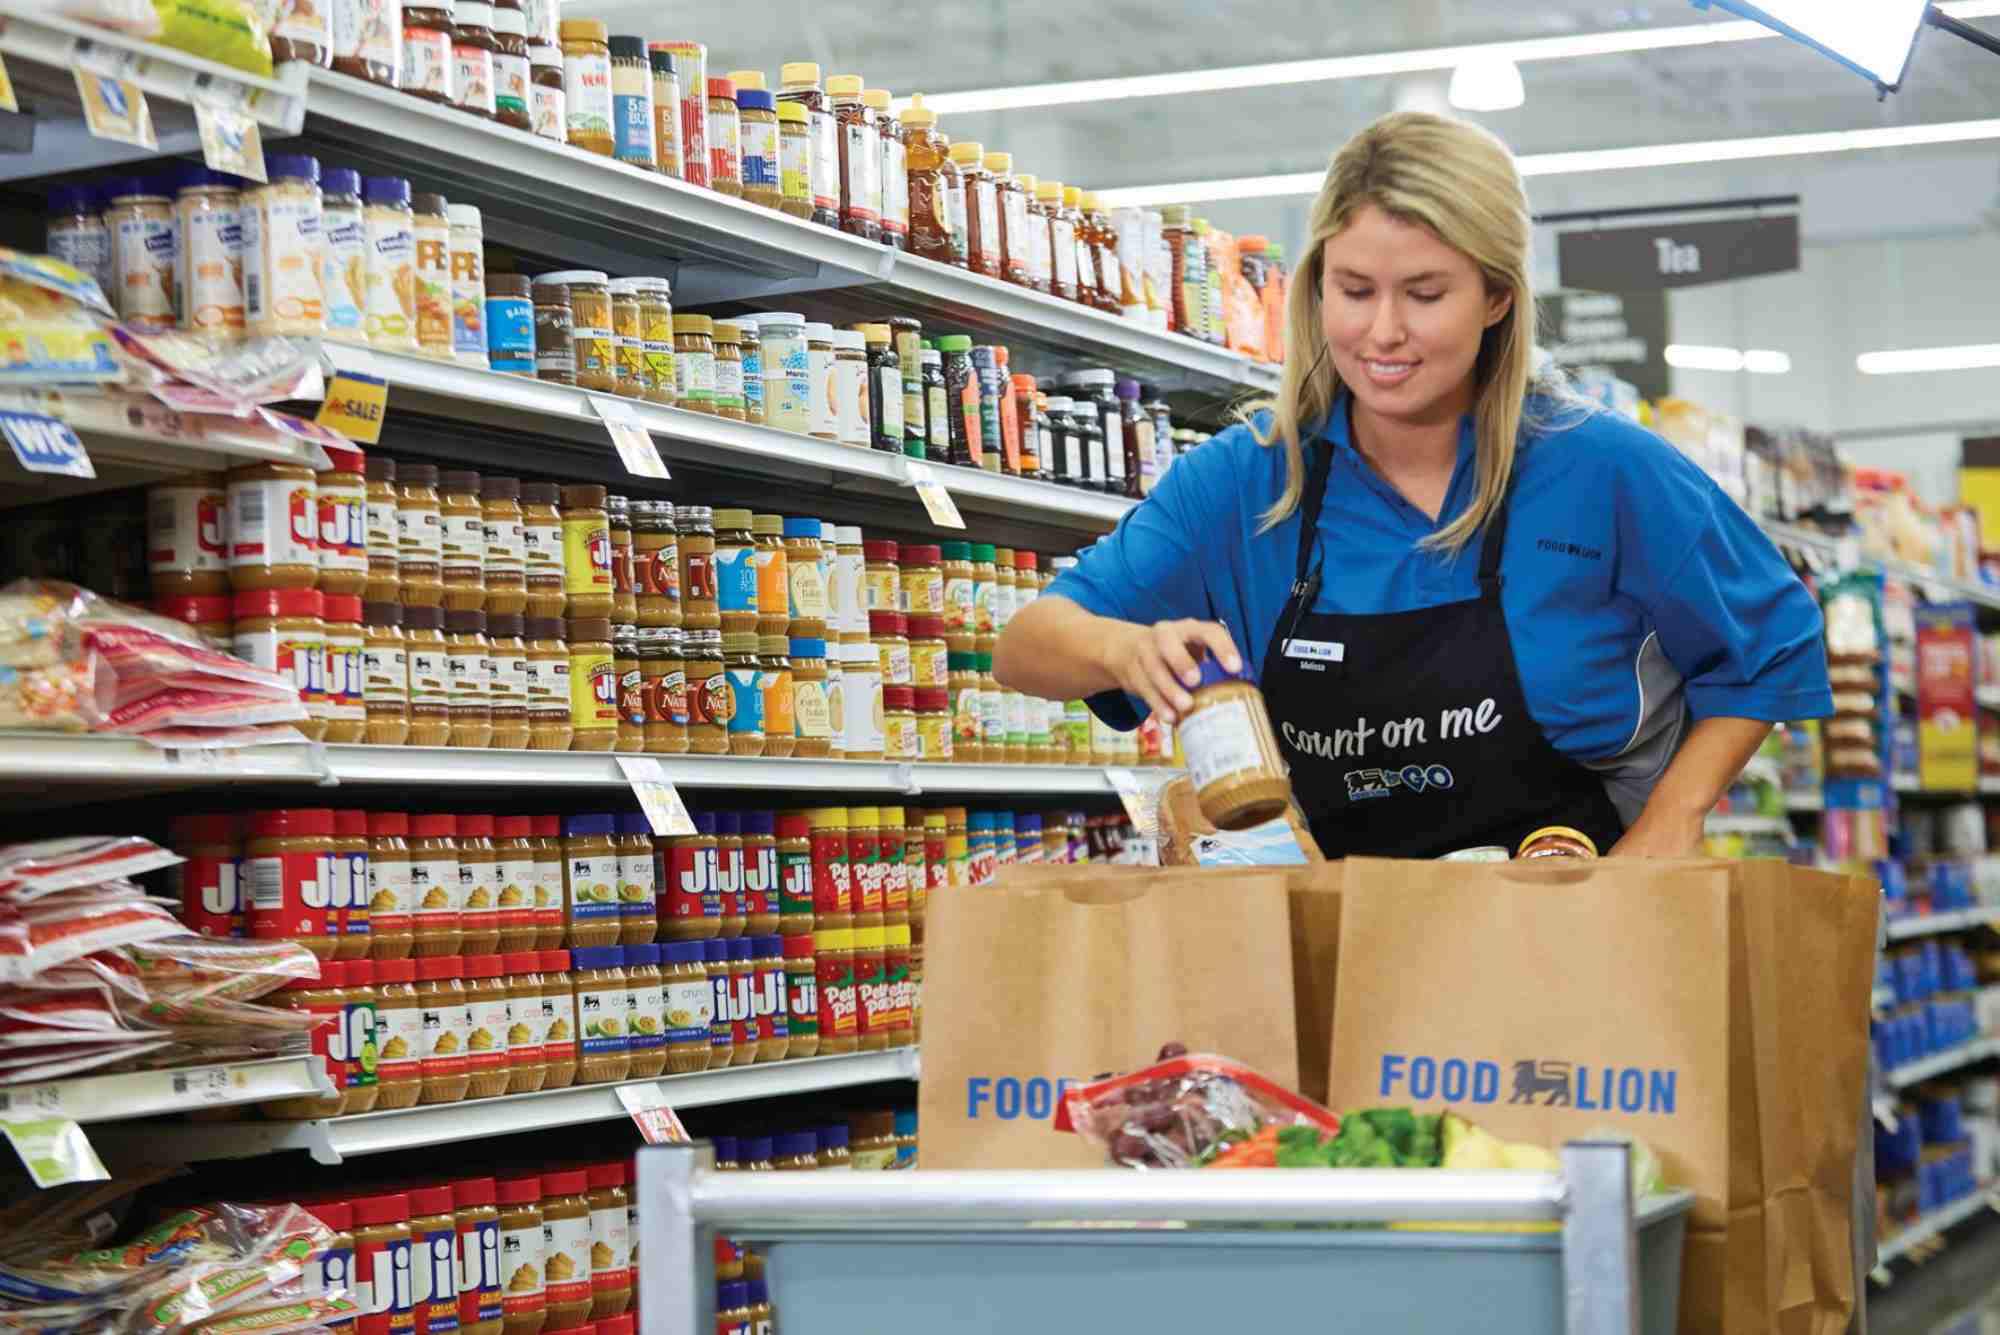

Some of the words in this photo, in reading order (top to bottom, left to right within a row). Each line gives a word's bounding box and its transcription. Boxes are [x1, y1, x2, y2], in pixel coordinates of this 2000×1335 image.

[1653, 237, 1702, 275] Tea
[344, 398, 378, 421] SALE
[3, 416, 80, 458] WIC
[320, 503, 363, 544] Ji
[1381, 716, 1427, 748] on
[1439, 697, 1503, 740] me
[680, 848, 717, 893] Ji
[745, 847, 778, 891] Ji
[1380, 1054, 1500, 1105] FOOD
[1575, 1066, 1678, 1115] LION
